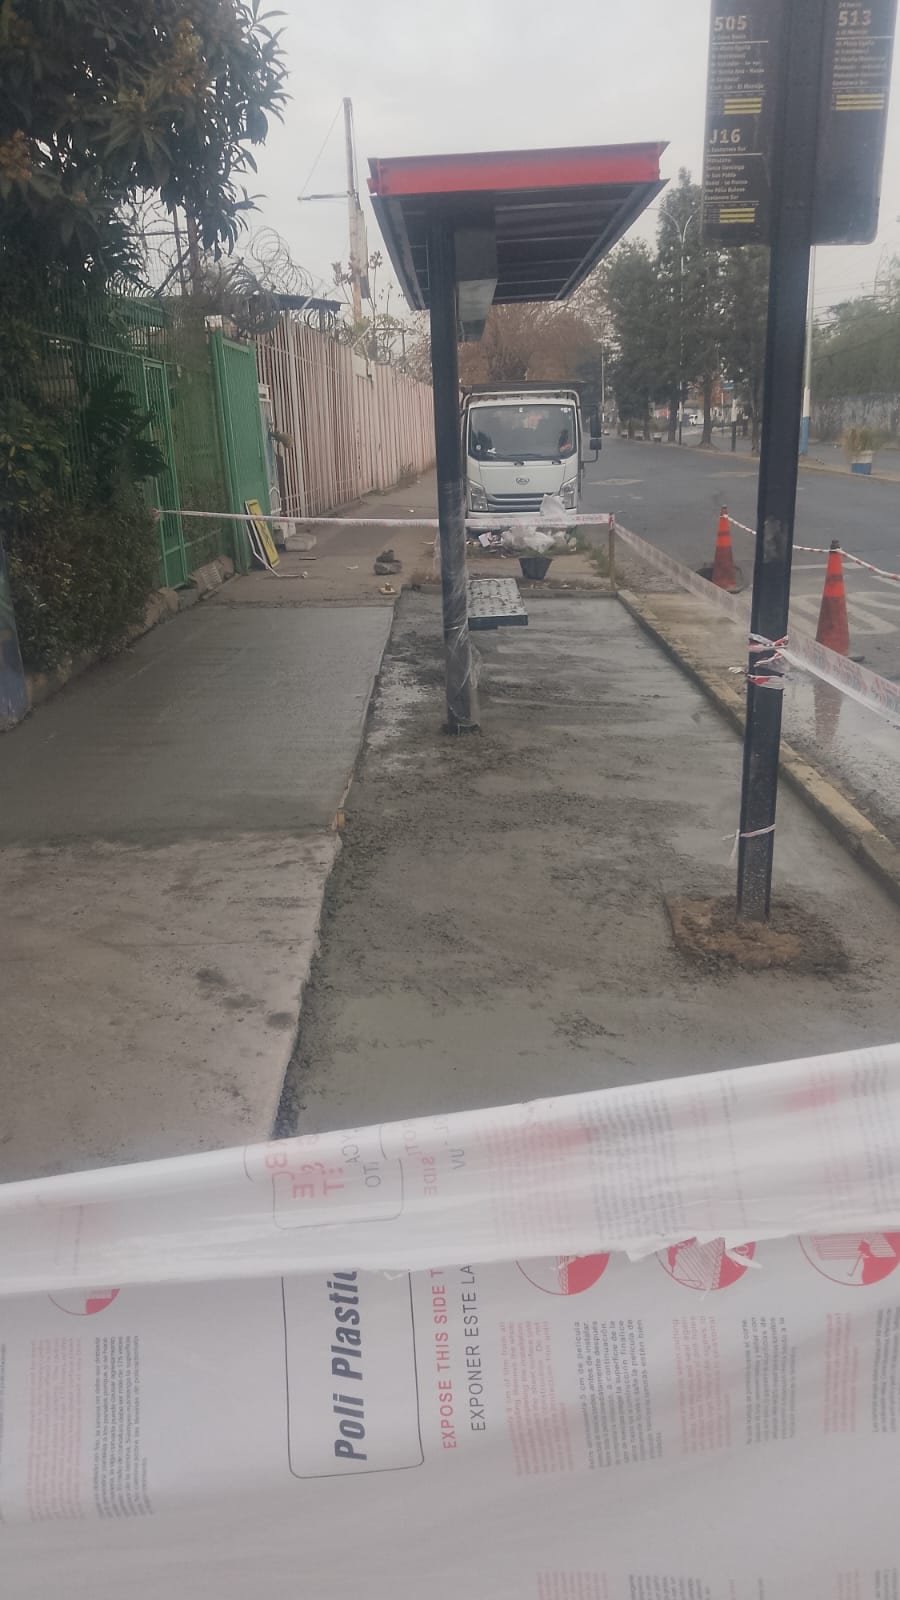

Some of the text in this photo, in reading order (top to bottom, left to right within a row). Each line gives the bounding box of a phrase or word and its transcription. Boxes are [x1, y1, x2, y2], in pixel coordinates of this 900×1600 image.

[714, 15, 747, 31] 505
[838, 9, 872, 26] 513
[709, 128, 741, 144] J16
[431, 1285, 448, 1324] SIDE
[461, 1292, 479, 1337] ESTE
[435, 1332, 450, 1372] THIS
[465, 1345, 486, 1431] EXPONER
[332, 1393, 367, 1461] Poli
[438, 1380, 457, 1449] EXPOSE
